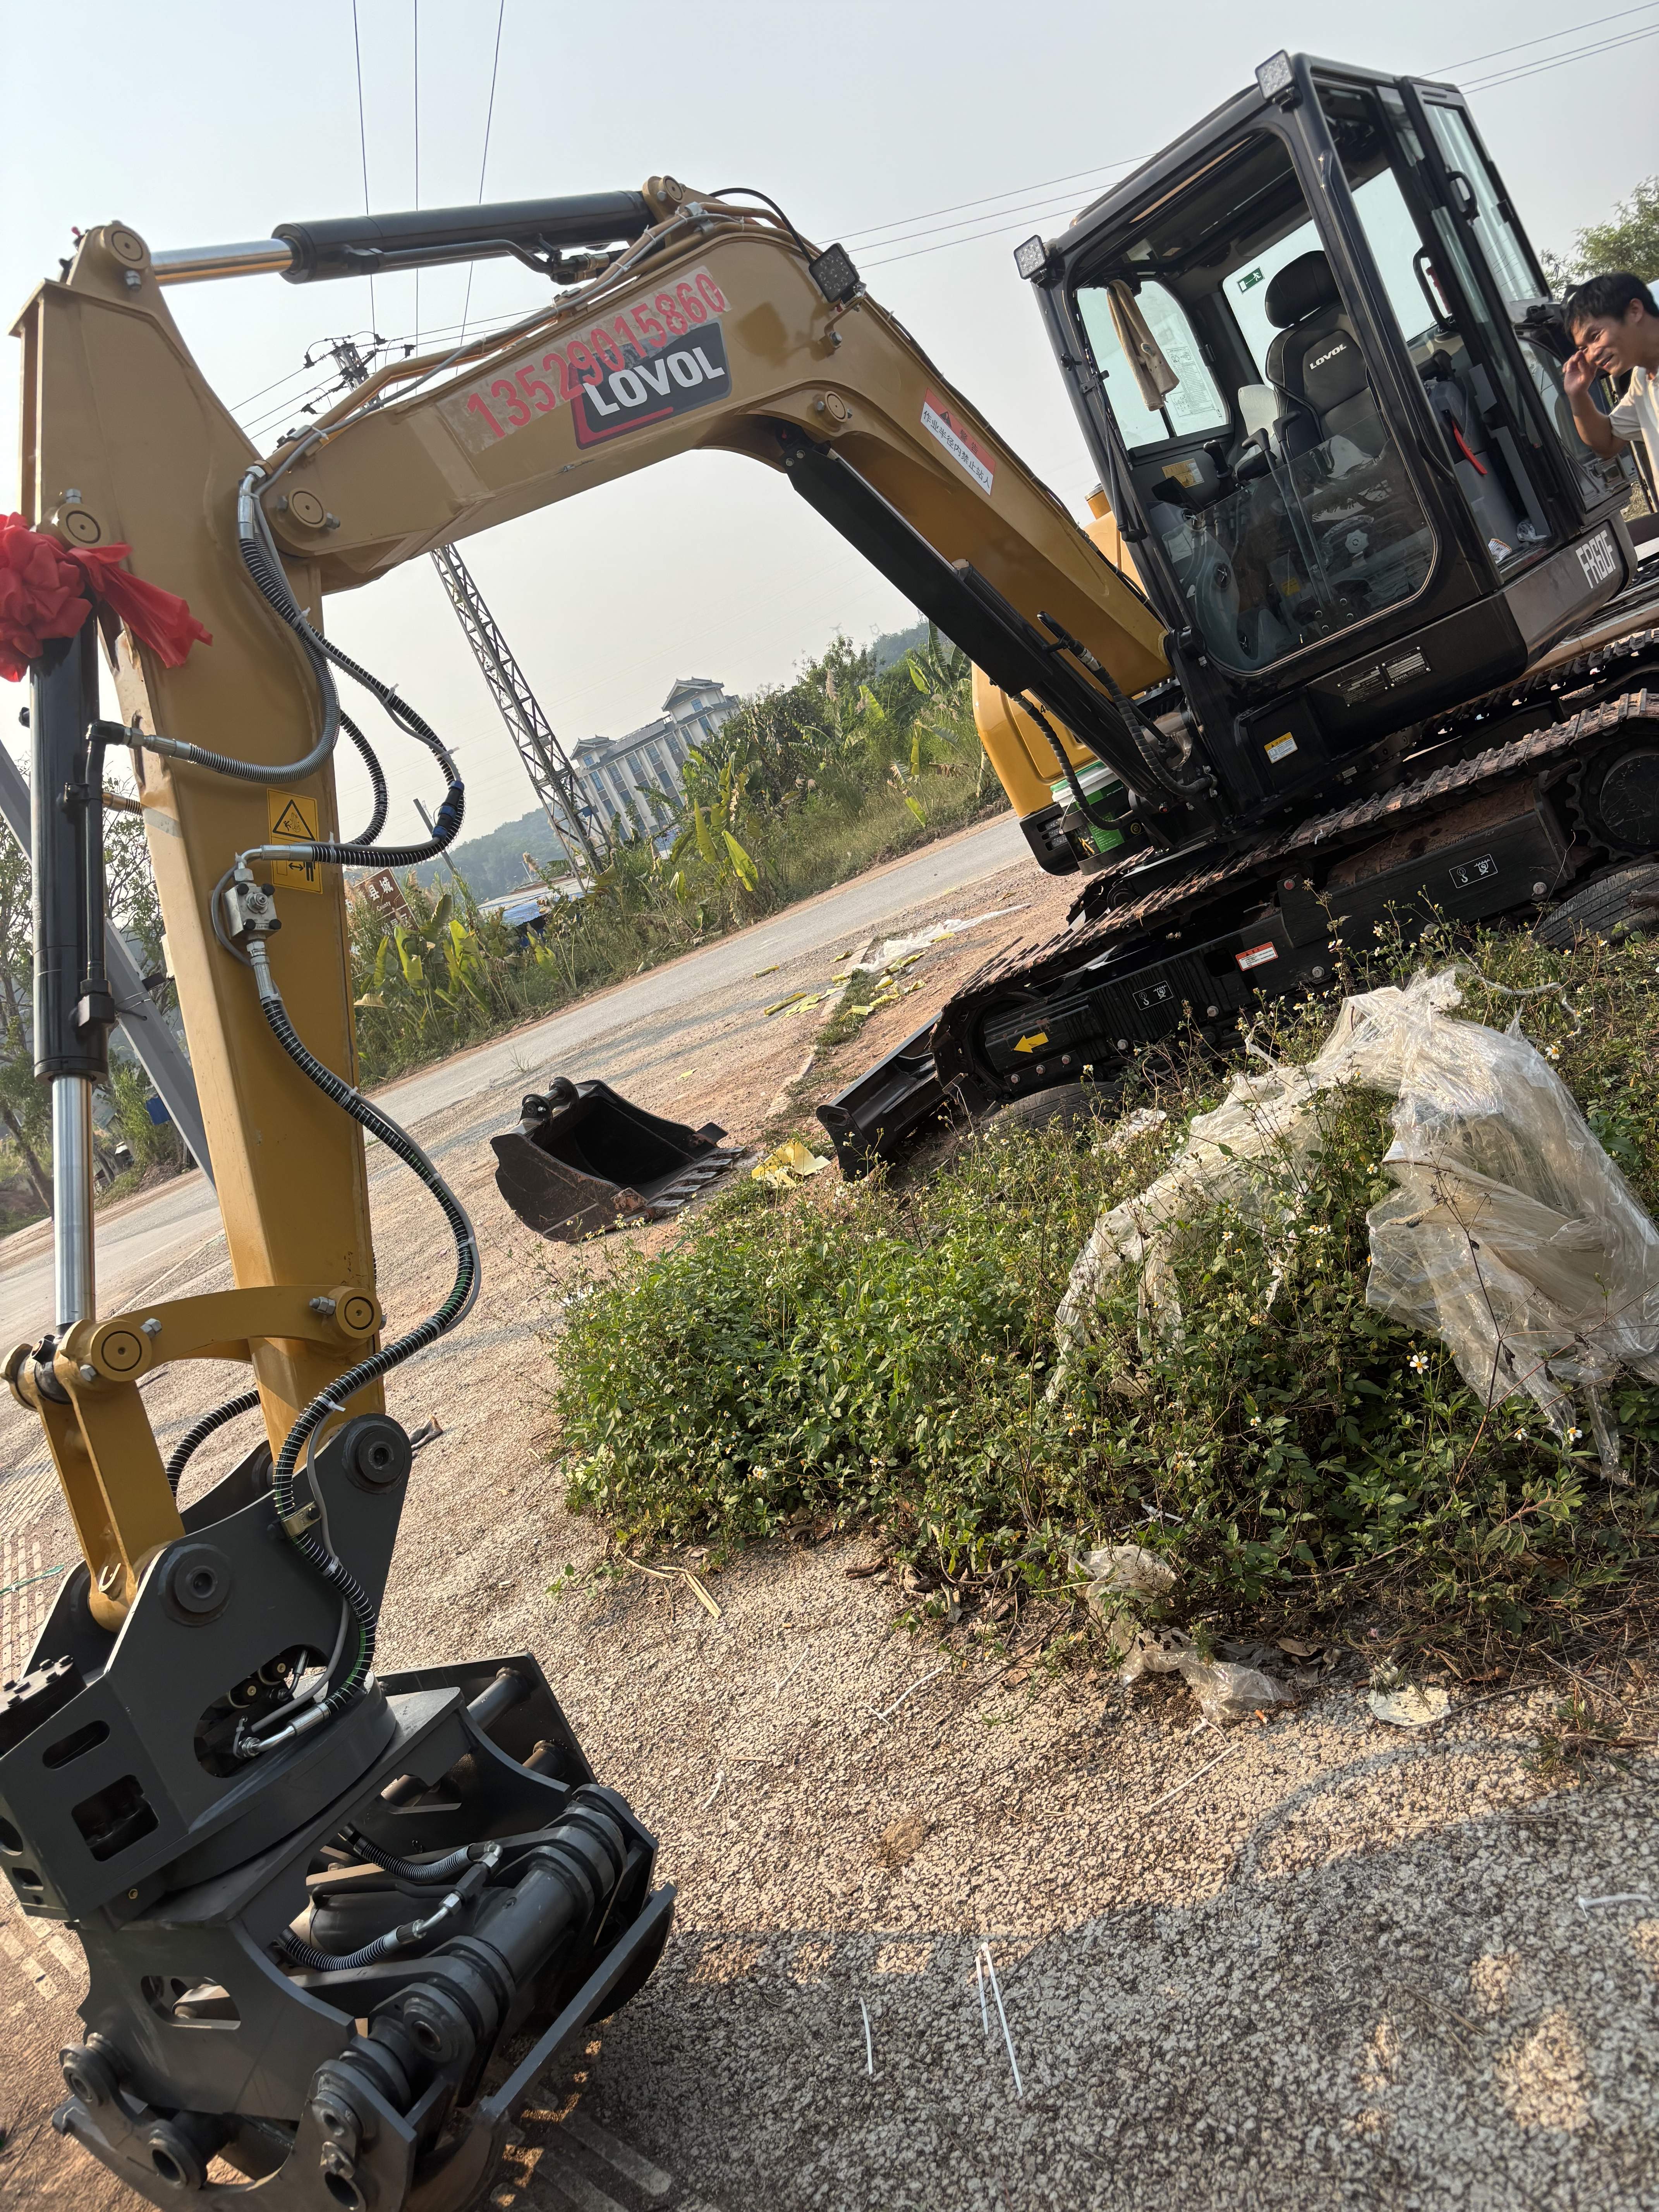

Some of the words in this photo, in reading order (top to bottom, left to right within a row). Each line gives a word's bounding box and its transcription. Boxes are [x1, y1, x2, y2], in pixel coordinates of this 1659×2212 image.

[467, 273, 725, 438] 13529015860
[582, 347, 725, 416] LOVOL
[1310, 344, 1346, 369] LOVOL
[924, 410, 990, 488] 作业半径内禁止站人
[960, 429, 978, 455] 警告
[1575, 530, 1616, 589] FR60F
